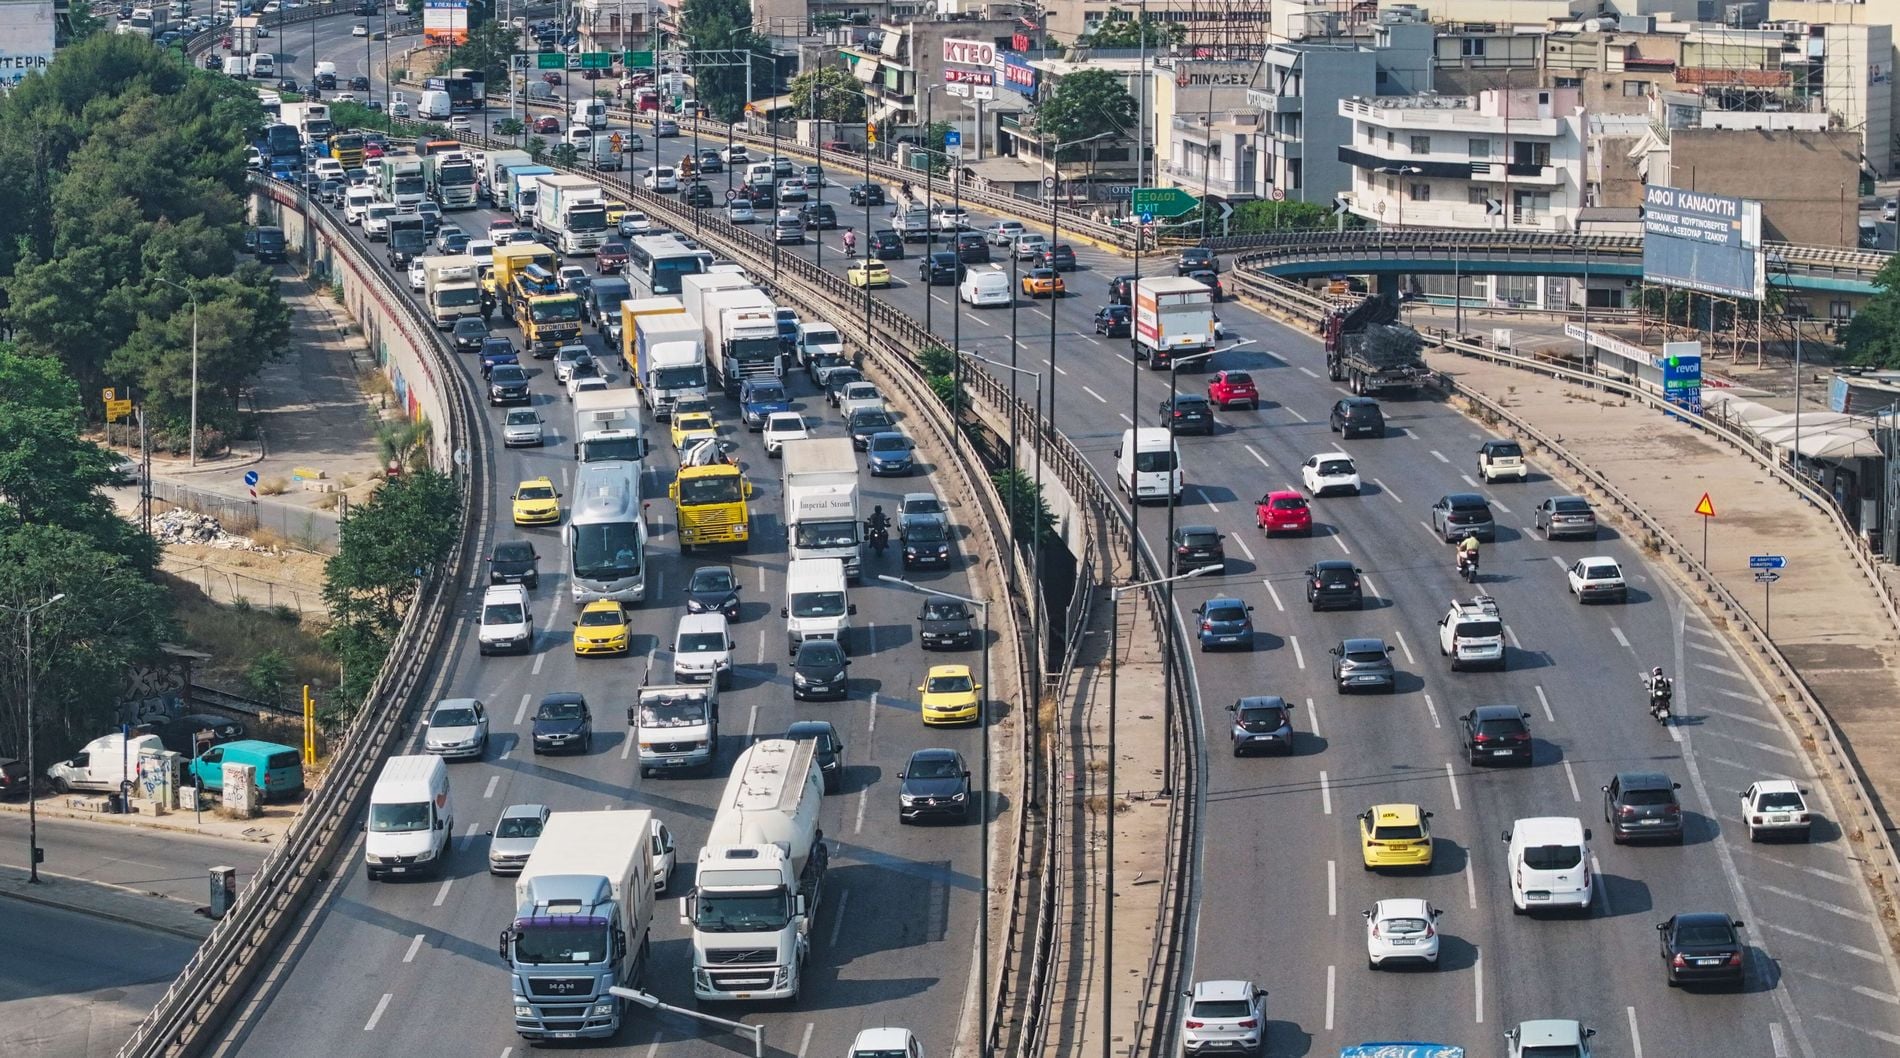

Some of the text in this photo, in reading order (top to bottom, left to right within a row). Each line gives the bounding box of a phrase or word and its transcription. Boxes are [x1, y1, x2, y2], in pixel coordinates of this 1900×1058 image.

[1012, 32, 1030, 52] ΚΤΕΟ
[944, 41, 993, 64] ΚΤΕΟ
[1137, 203, 1159, 213] EXIT
[1647, 189, 1736, 216] ΑΦΟΙ ΚΑΝΑΟΥΤΗ
[1646, 210, 1679, 224] ΜΕΤΑΛΛΙΚΕΣ
[1675, 363, 1699, 373] revoil
[800, 500, 827, 511] Imperial
